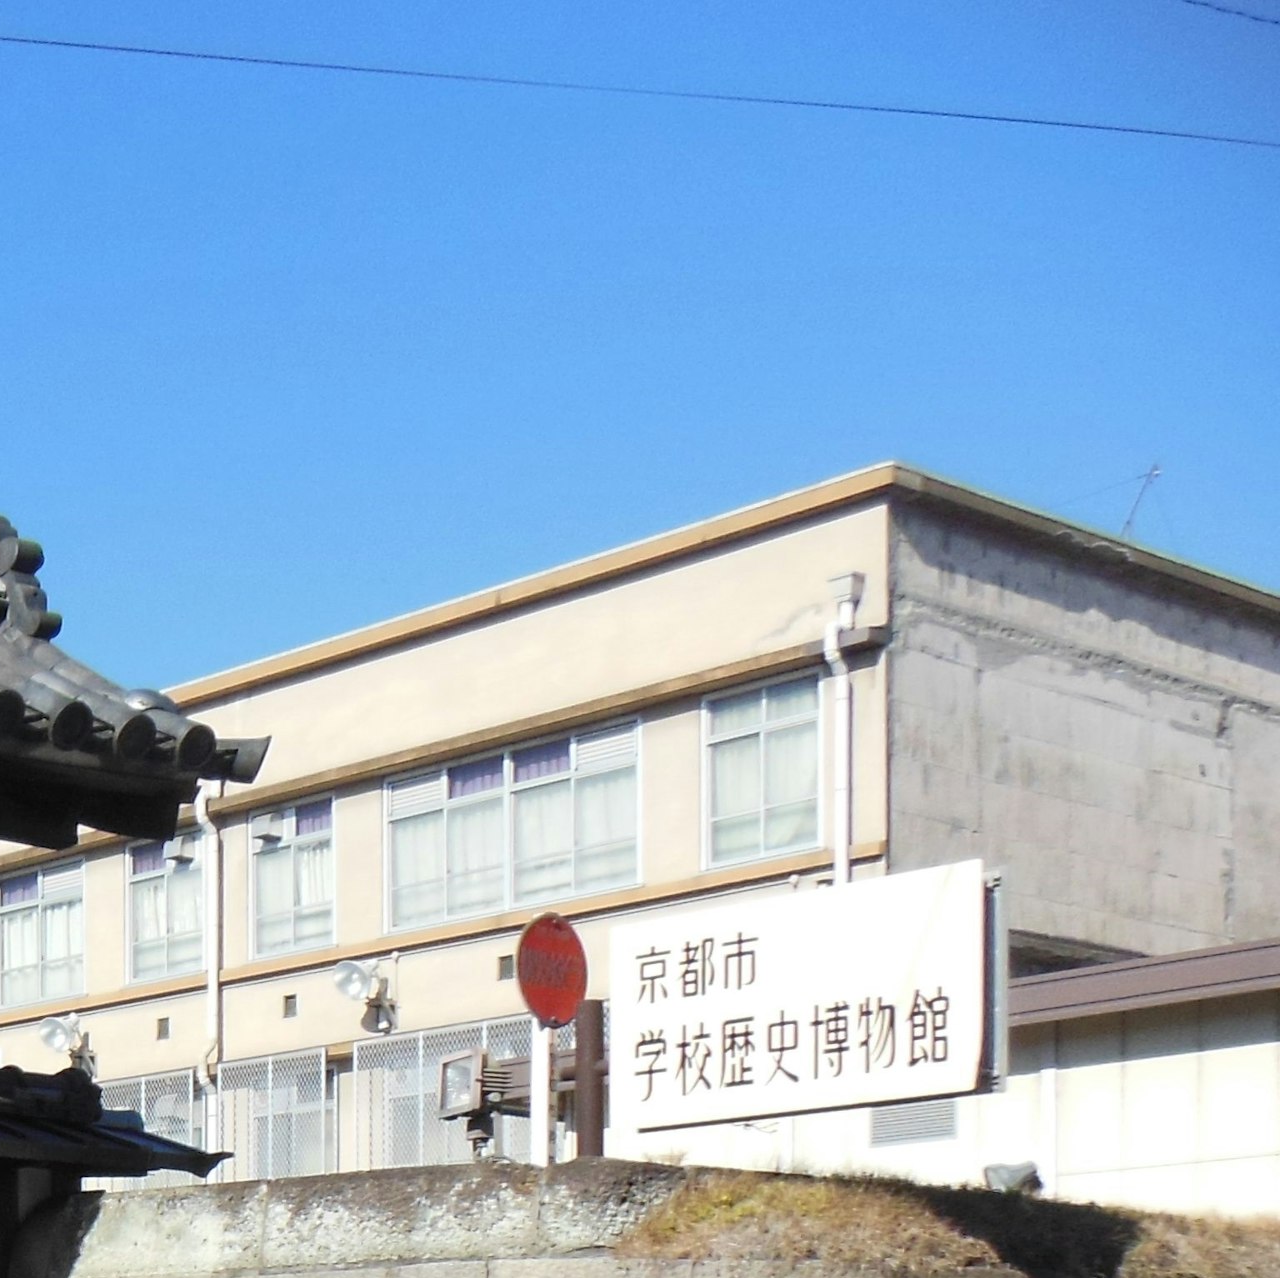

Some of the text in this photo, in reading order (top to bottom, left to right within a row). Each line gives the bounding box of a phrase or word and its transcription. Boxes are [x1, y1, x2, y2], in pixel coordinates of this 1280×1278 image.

[635, 932, 759, 1004] 京都市
[633, 987, 951, 1103] 学校歴史博物館
